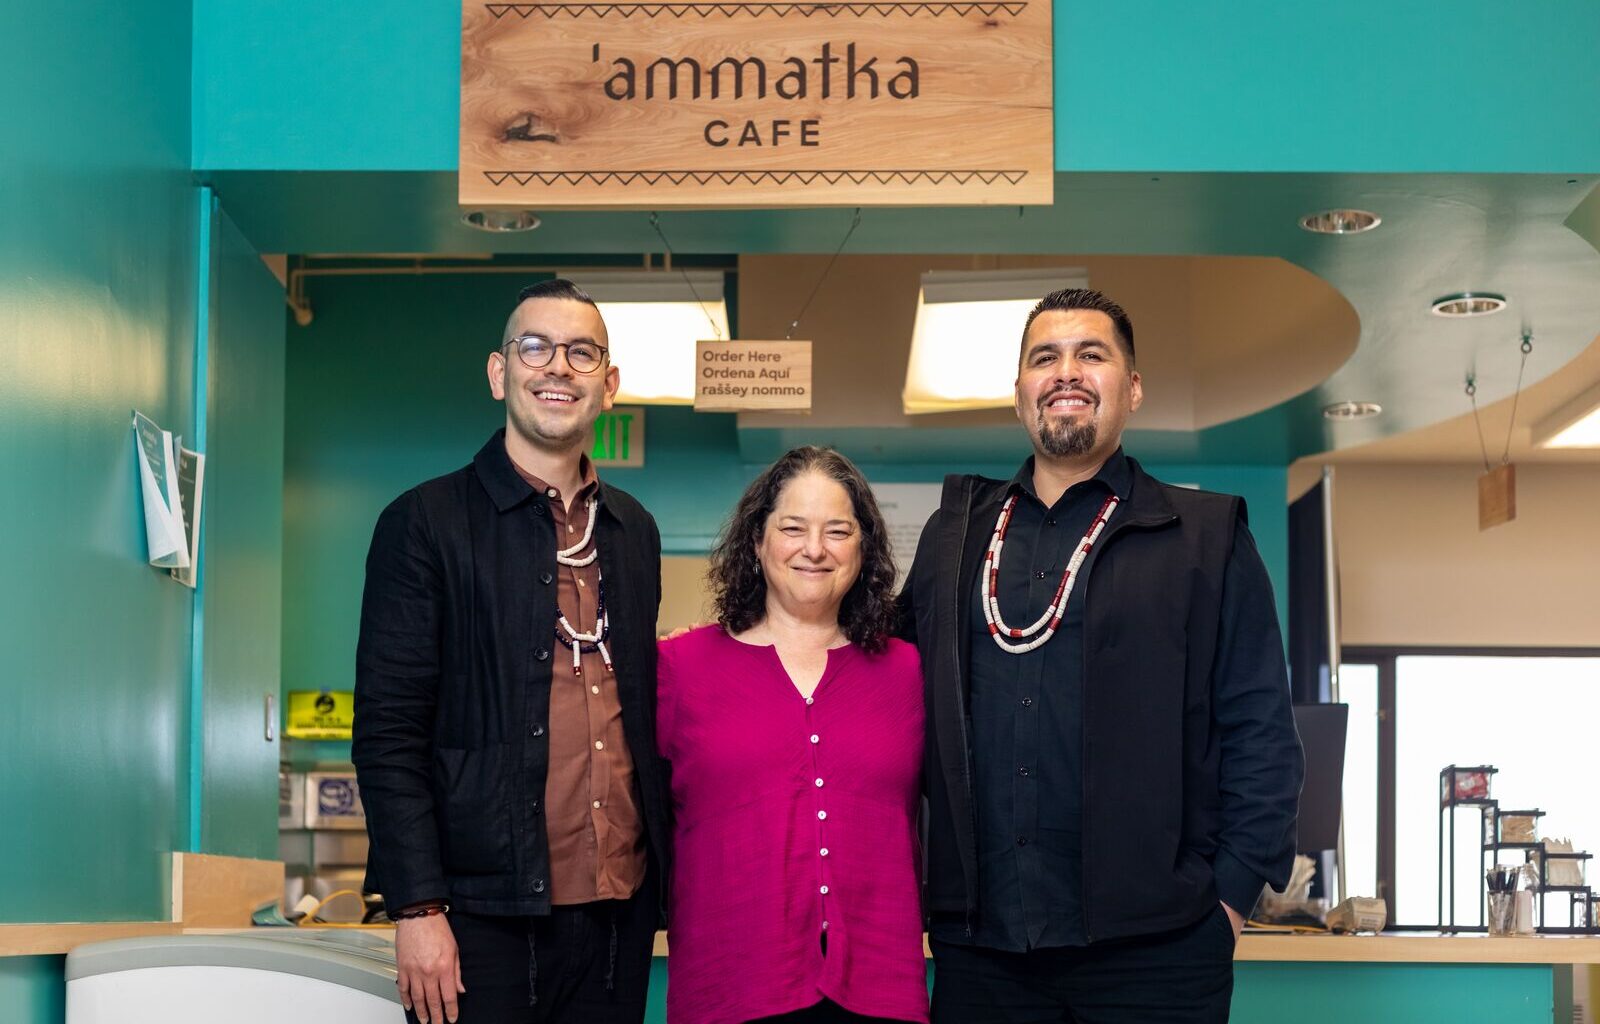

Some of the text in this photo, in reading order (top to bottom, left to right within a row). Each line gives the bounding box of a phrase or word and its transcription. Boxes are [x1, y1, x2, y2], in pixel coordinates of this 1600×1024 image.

[703, 119, 822, 147] CAFE
[702, 350, 782, 362] Order Here
[702, 366, 792, 381] Ordena Aquí
[752, 386, 805, 396] nommo
[591, 414, 634, 461] XIT
